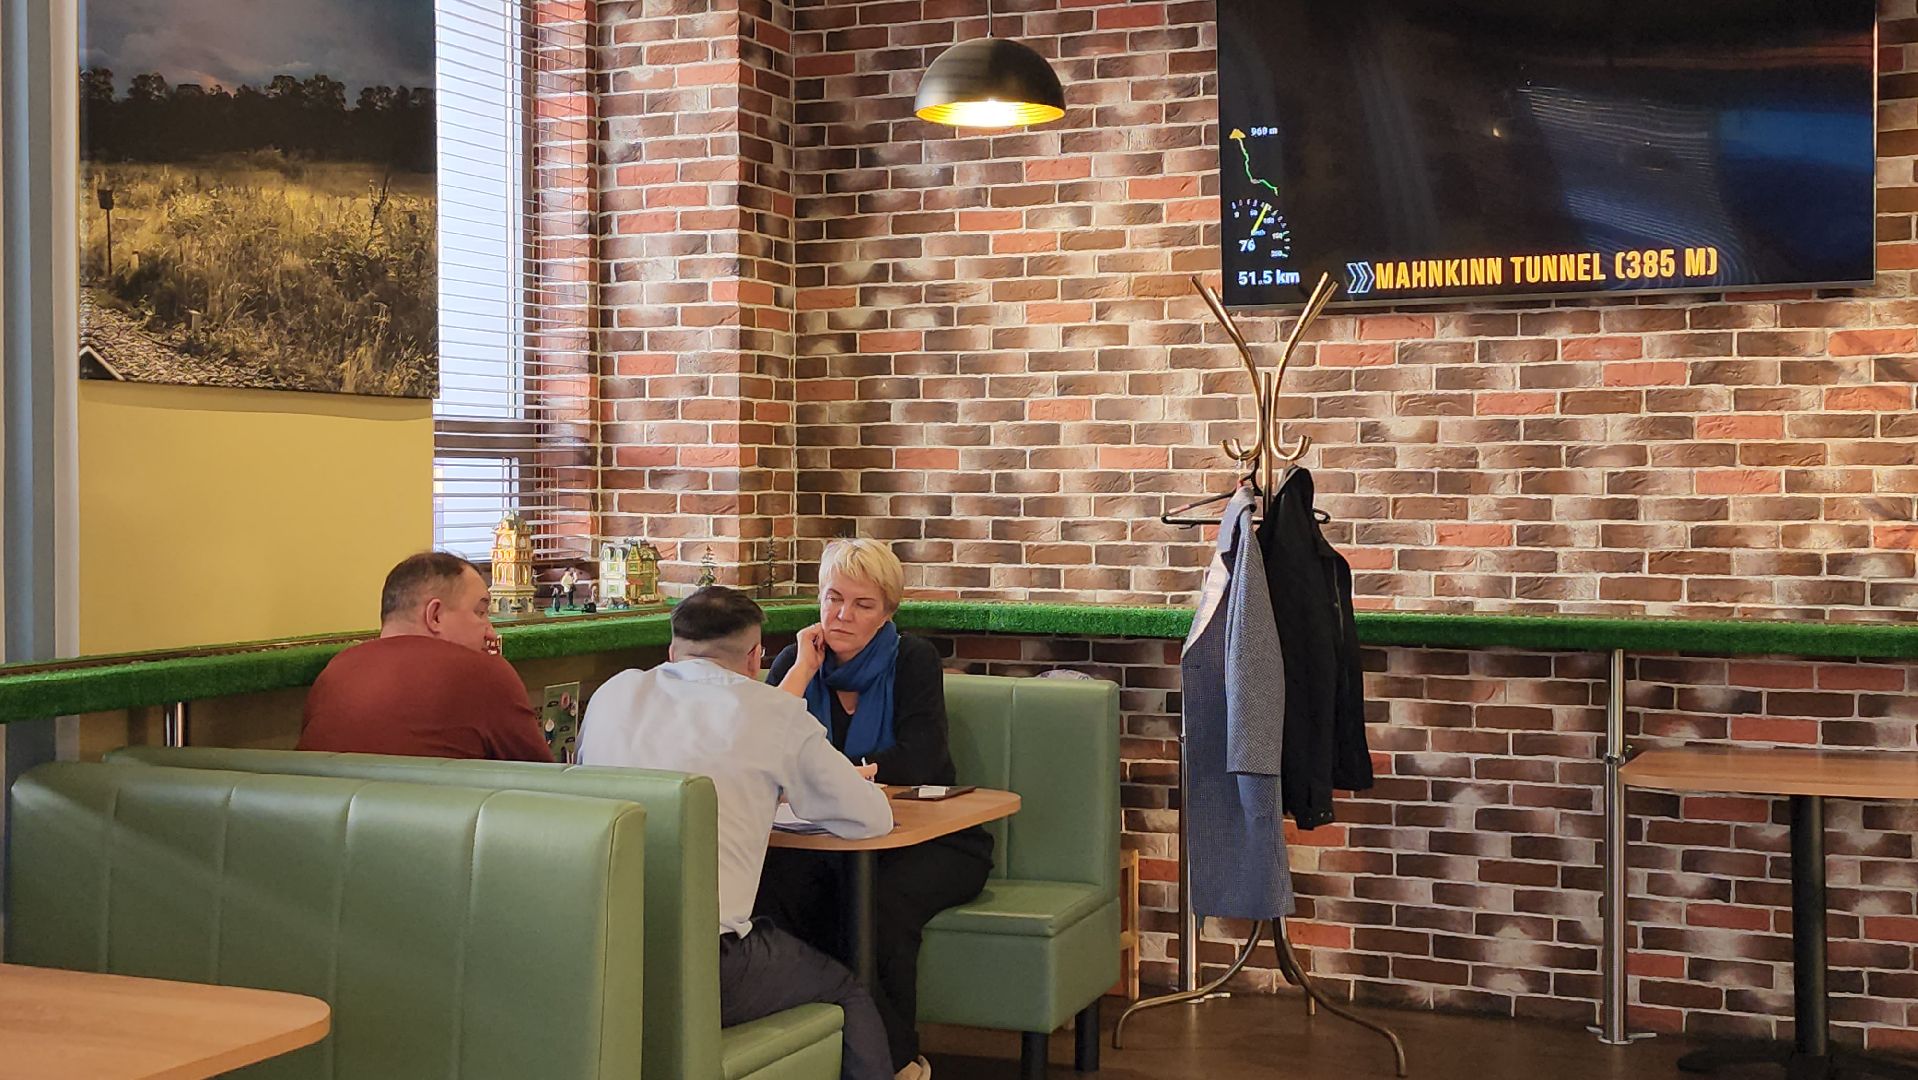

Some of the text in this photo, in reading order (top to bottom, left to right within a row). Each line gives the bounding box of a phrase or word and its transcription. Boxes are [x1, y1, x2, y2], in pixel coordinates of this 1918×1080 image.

[1238, 238, 1256, 252] 76
[1238, 268, 1300, 285] 51.5 km
[1376, 246, 1718, 290] MAHNKINN TUNNEL (385 M)
